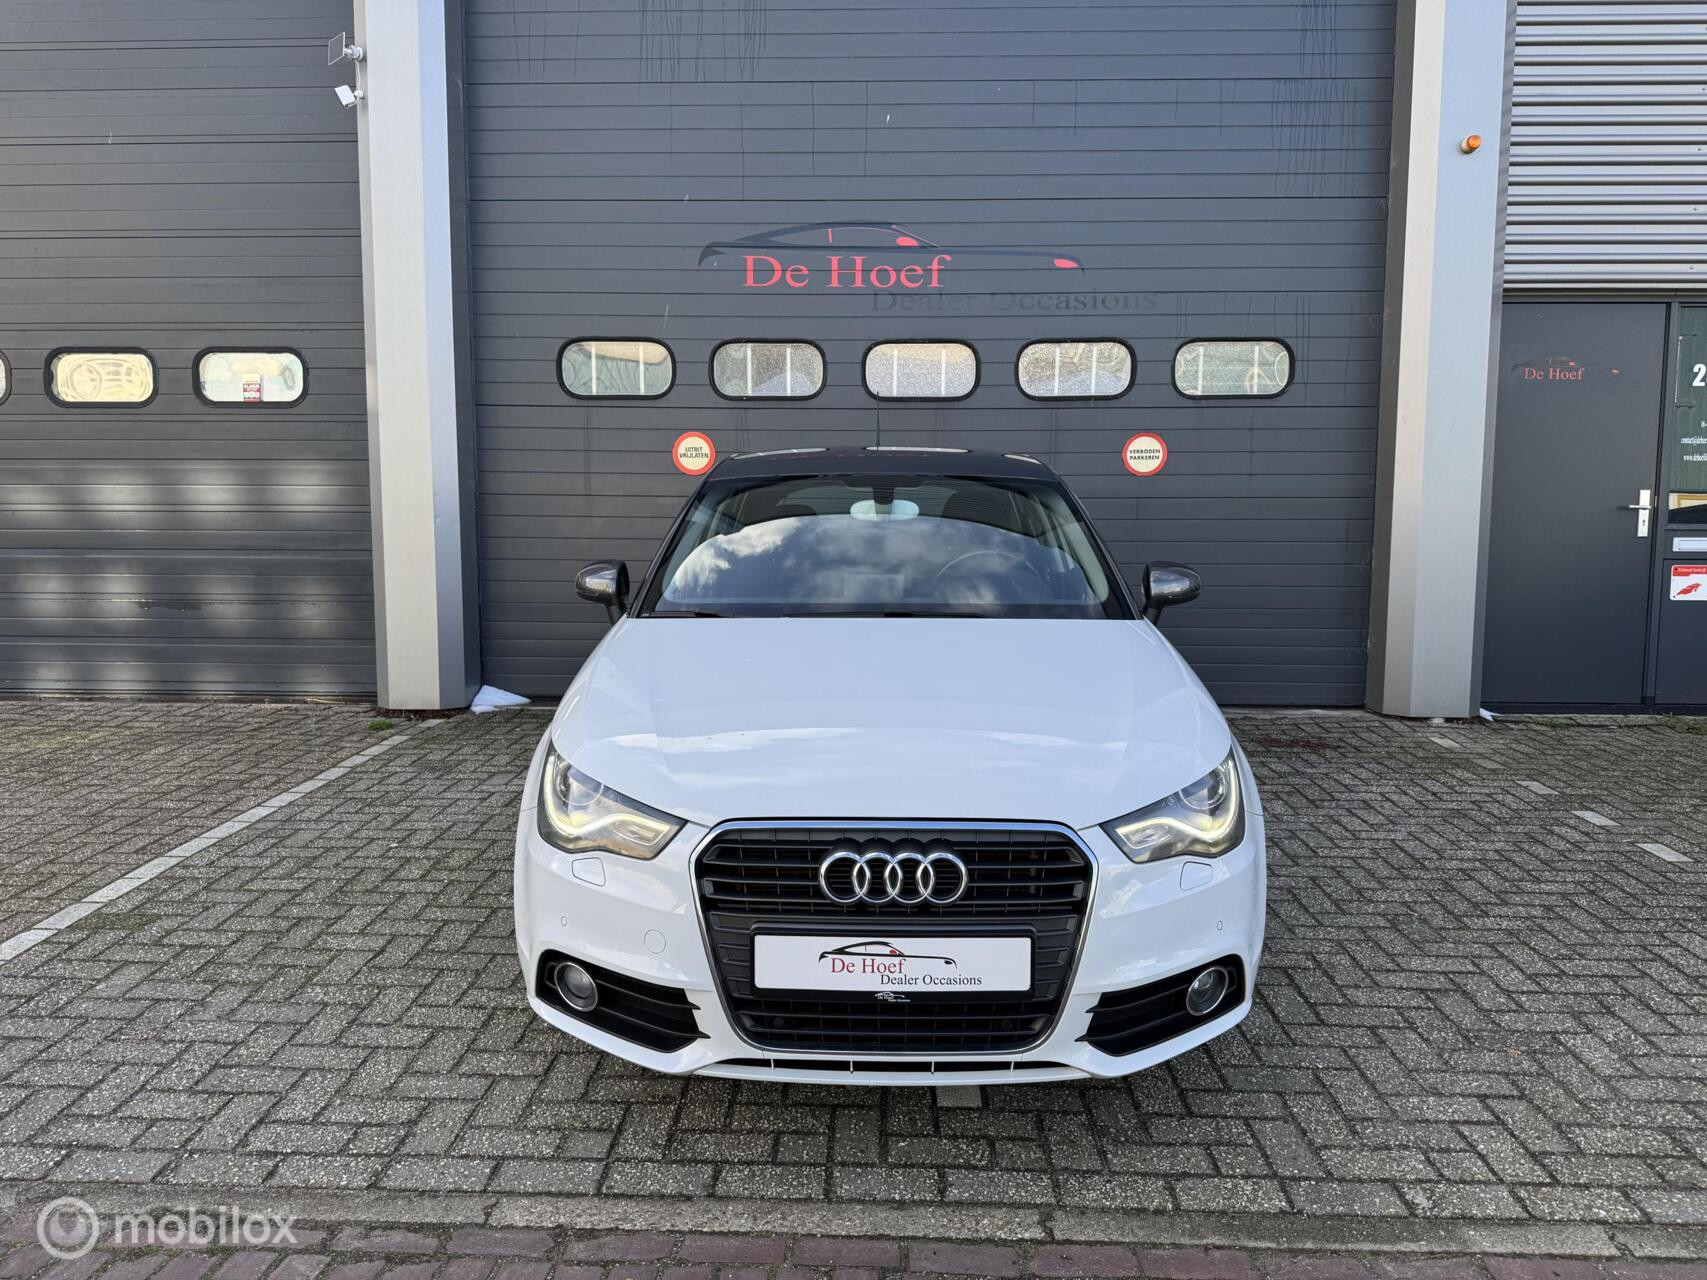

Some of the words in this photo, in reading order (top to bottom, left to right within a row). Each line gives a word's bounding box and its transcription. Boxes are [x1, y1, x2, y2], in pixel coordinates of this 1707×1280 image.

[741, 255, 809, 288] De
[826, 254, 952, 288] Hoef
[871, 288, 977, 312] Dealer
[990, 287, 1157, 312] Occasions
[1523, 367, 1544, 380] De
[1549, 367, 1585, 380] Hoef
[831, 957, 855, 973] De
[861, 957, 906, 974] Hoef
[880, 974, 919, 986] Dealer
[922, 974, 983, 986] Occasions
